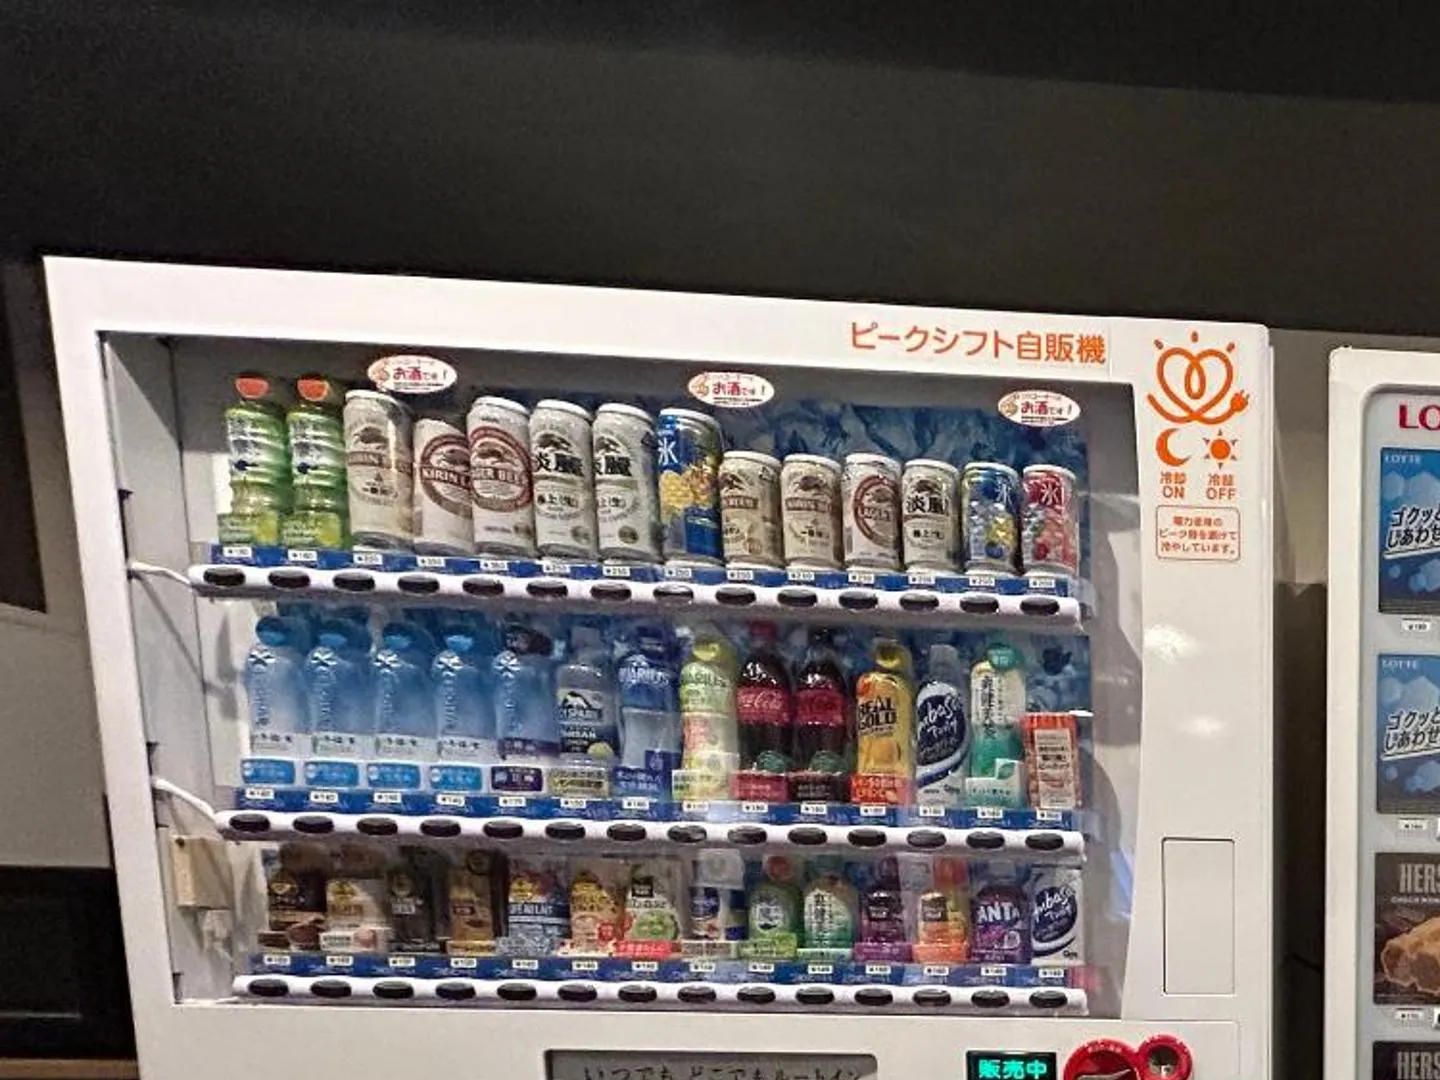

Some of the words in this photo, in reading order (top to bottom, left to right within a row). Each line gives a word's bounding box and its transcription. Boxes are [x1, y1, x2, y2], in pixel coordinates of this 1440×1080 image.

[851, 322, 1106, 365] ピークシフト自販機
[1162, 486, 1185, 499] ON
[1206, 487, 1236, 500] OFF
[975, 899, 1021, 923] ANTA
[978, 1058, 1048, 1080] 販売中
